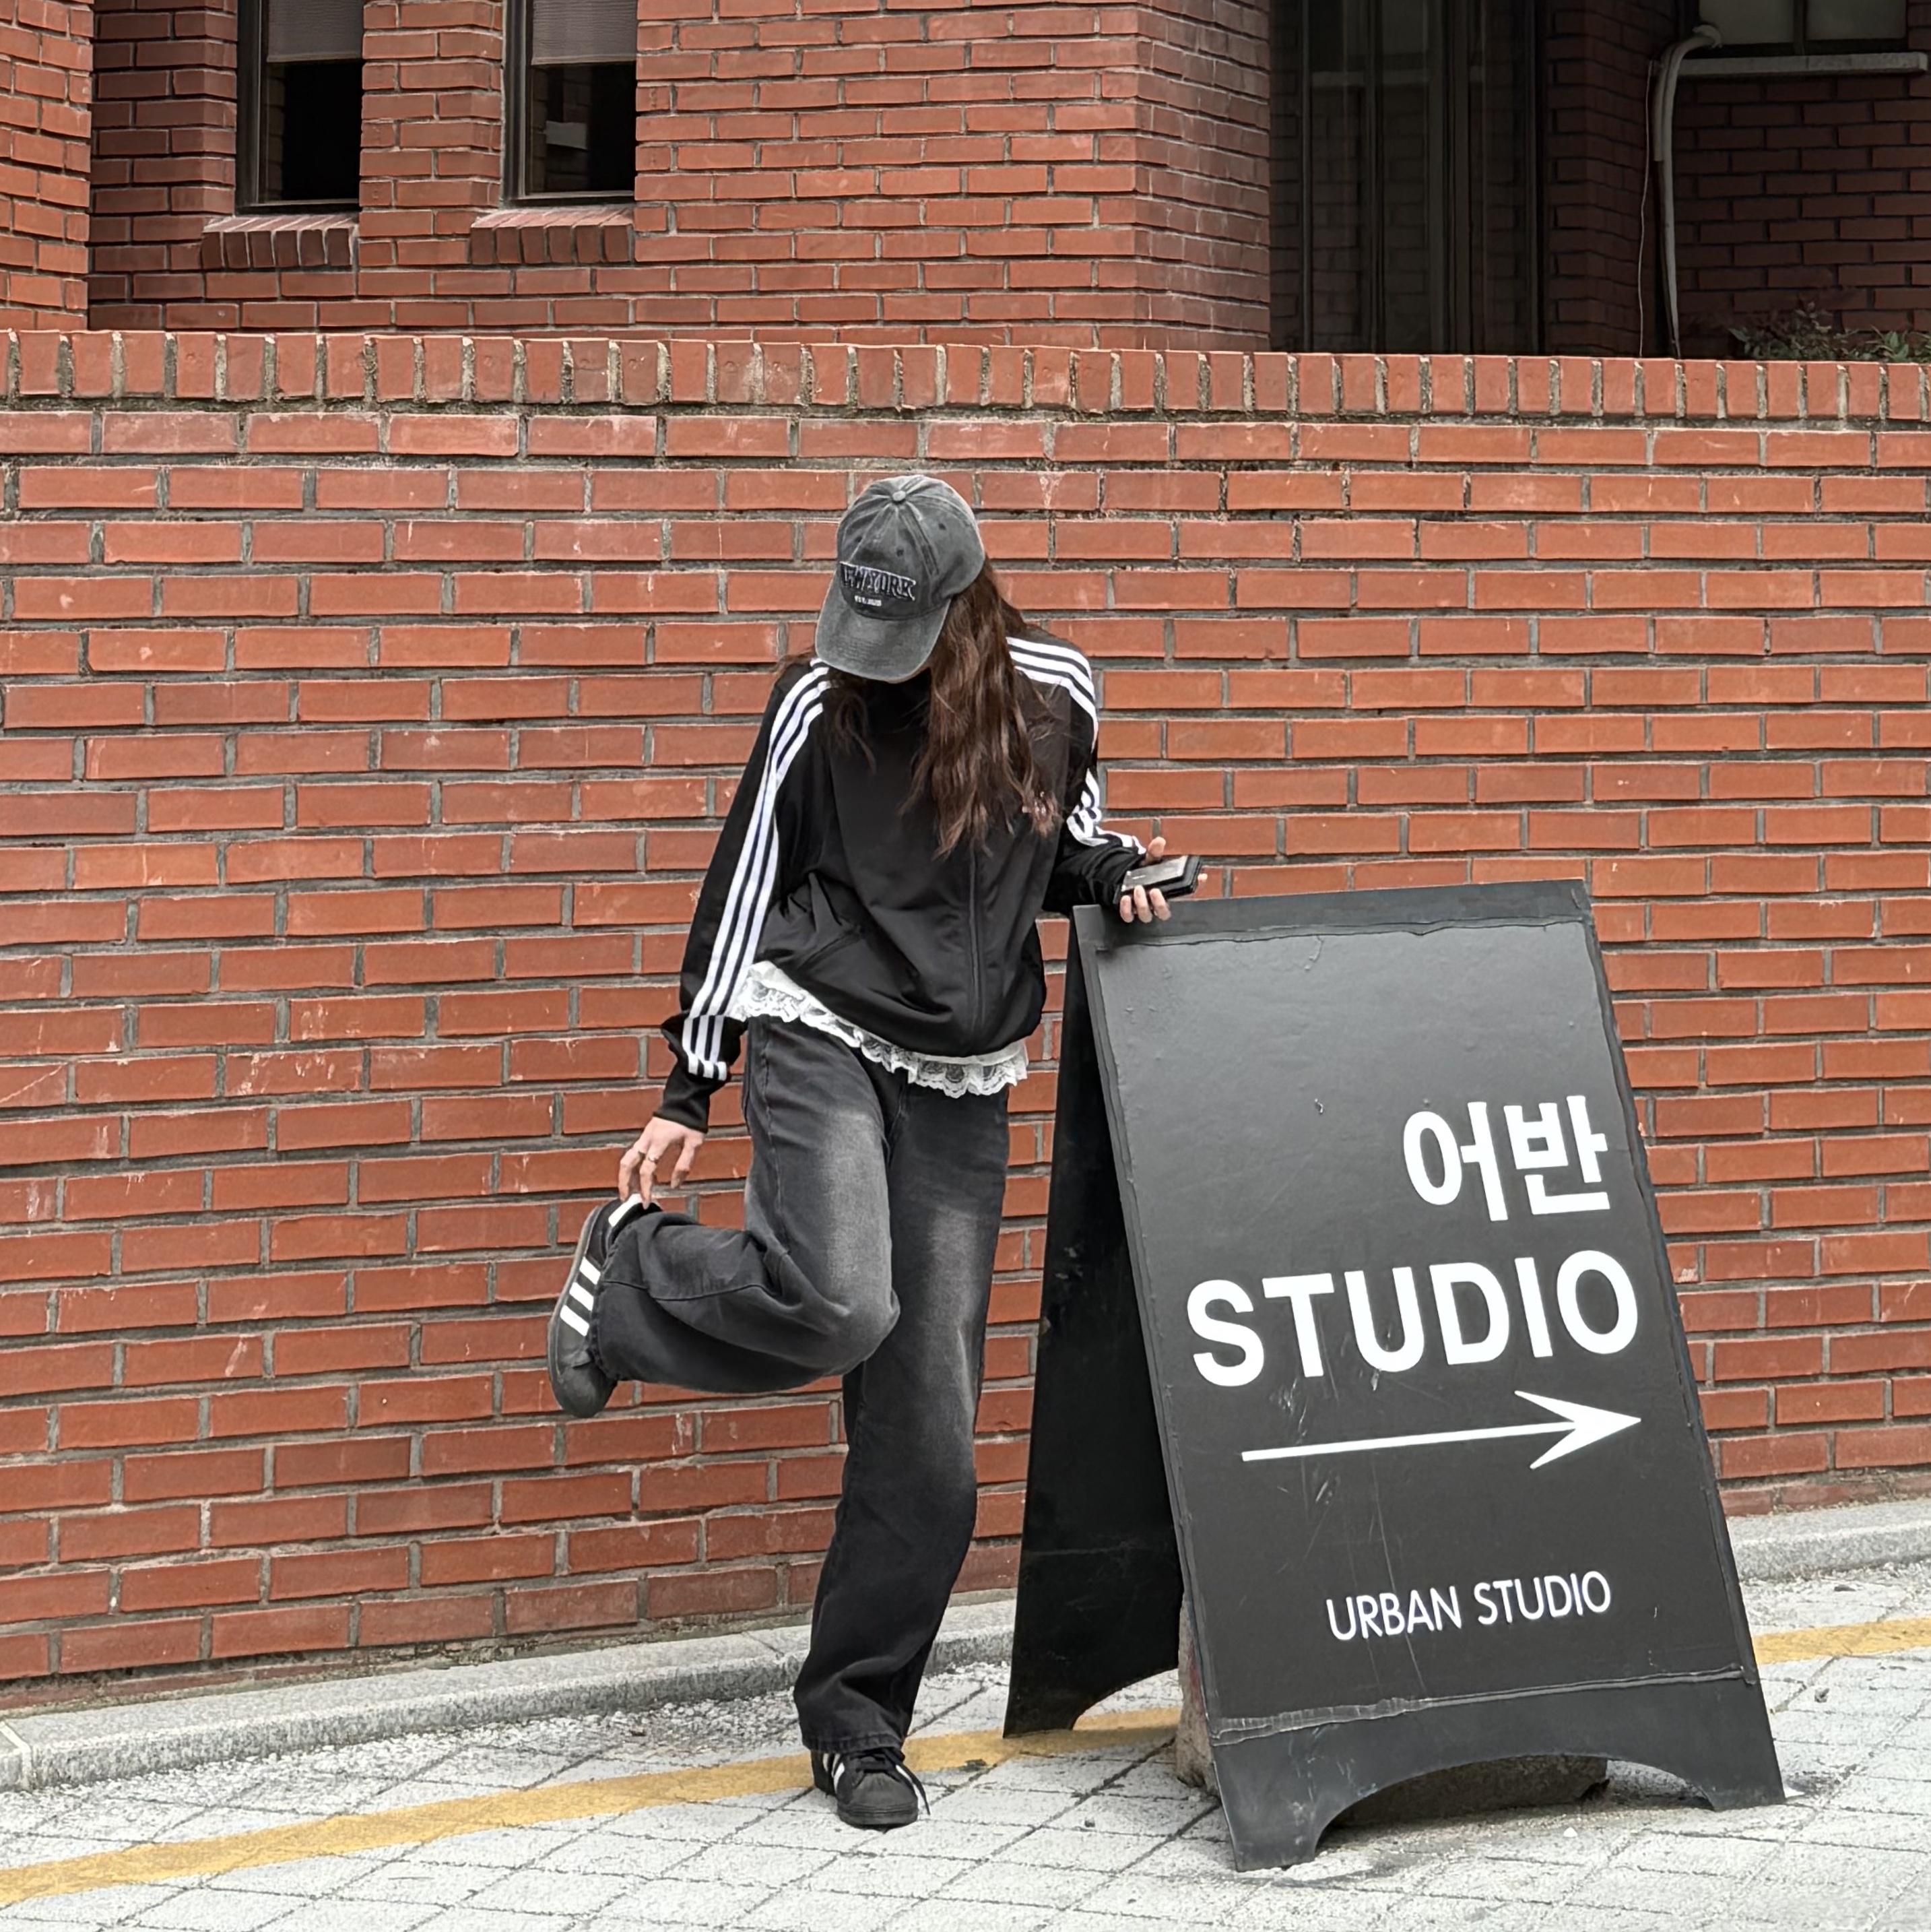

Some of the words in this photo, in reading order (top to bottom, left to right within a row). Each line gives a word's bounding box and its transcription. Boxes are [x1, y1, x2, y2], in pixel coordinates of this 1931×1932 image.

[1404, 1095, 1610, 1221] 어반
[1187, 1250, 1638, 1387] STUDIO
[1326, 1586, 1462, 1640] URBAN
[1474, 1571, 1611, 1625] STUDIO
